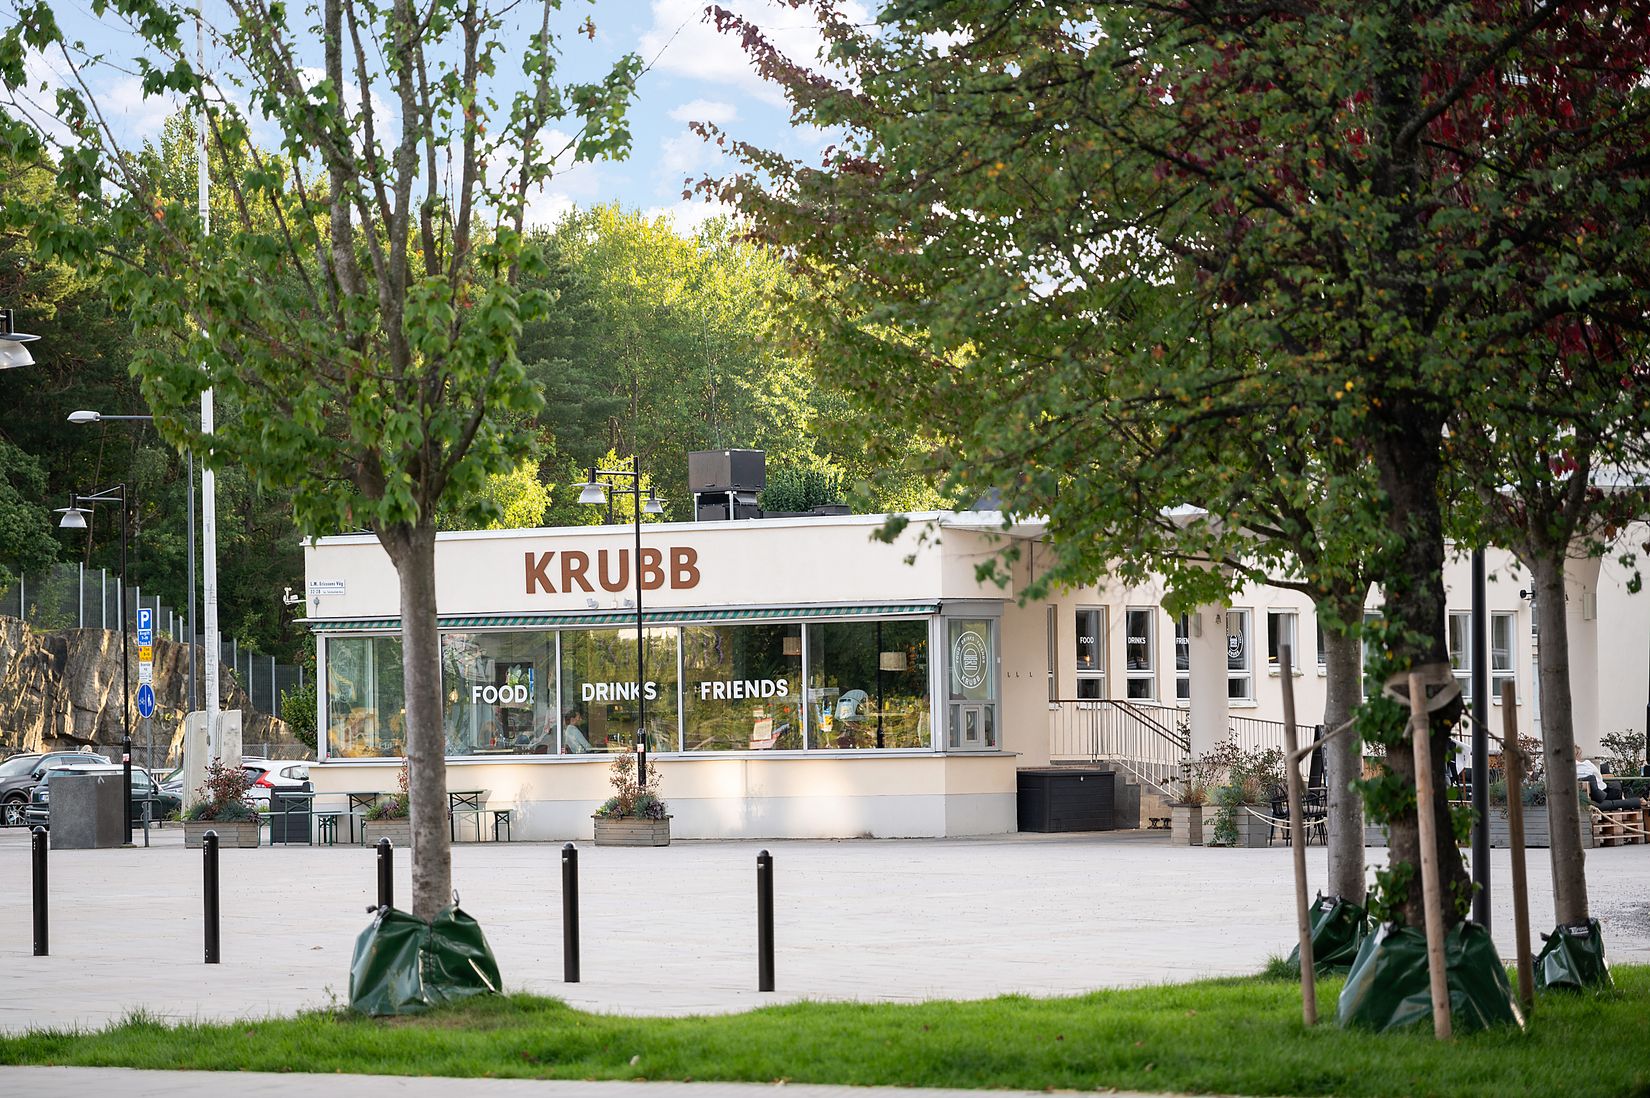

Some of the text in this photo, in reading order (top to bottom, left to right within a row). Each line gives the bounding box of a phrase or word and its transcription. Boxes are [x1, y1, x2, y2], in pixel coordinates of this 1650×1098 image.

[525, 547, 701, 594] KRUBB
[140, 611, 150, 628] P
[1079, 636, 1095, 644] FOOD
[1127, 636, 1147, 644] DRINKS
[1176, 637, 1190, 645] FRIEN
[472, 685, 528, 704] FOOD
[581, 681, 658, 702] DRINKS
[700, 679, 789, 700] FRIENDS
